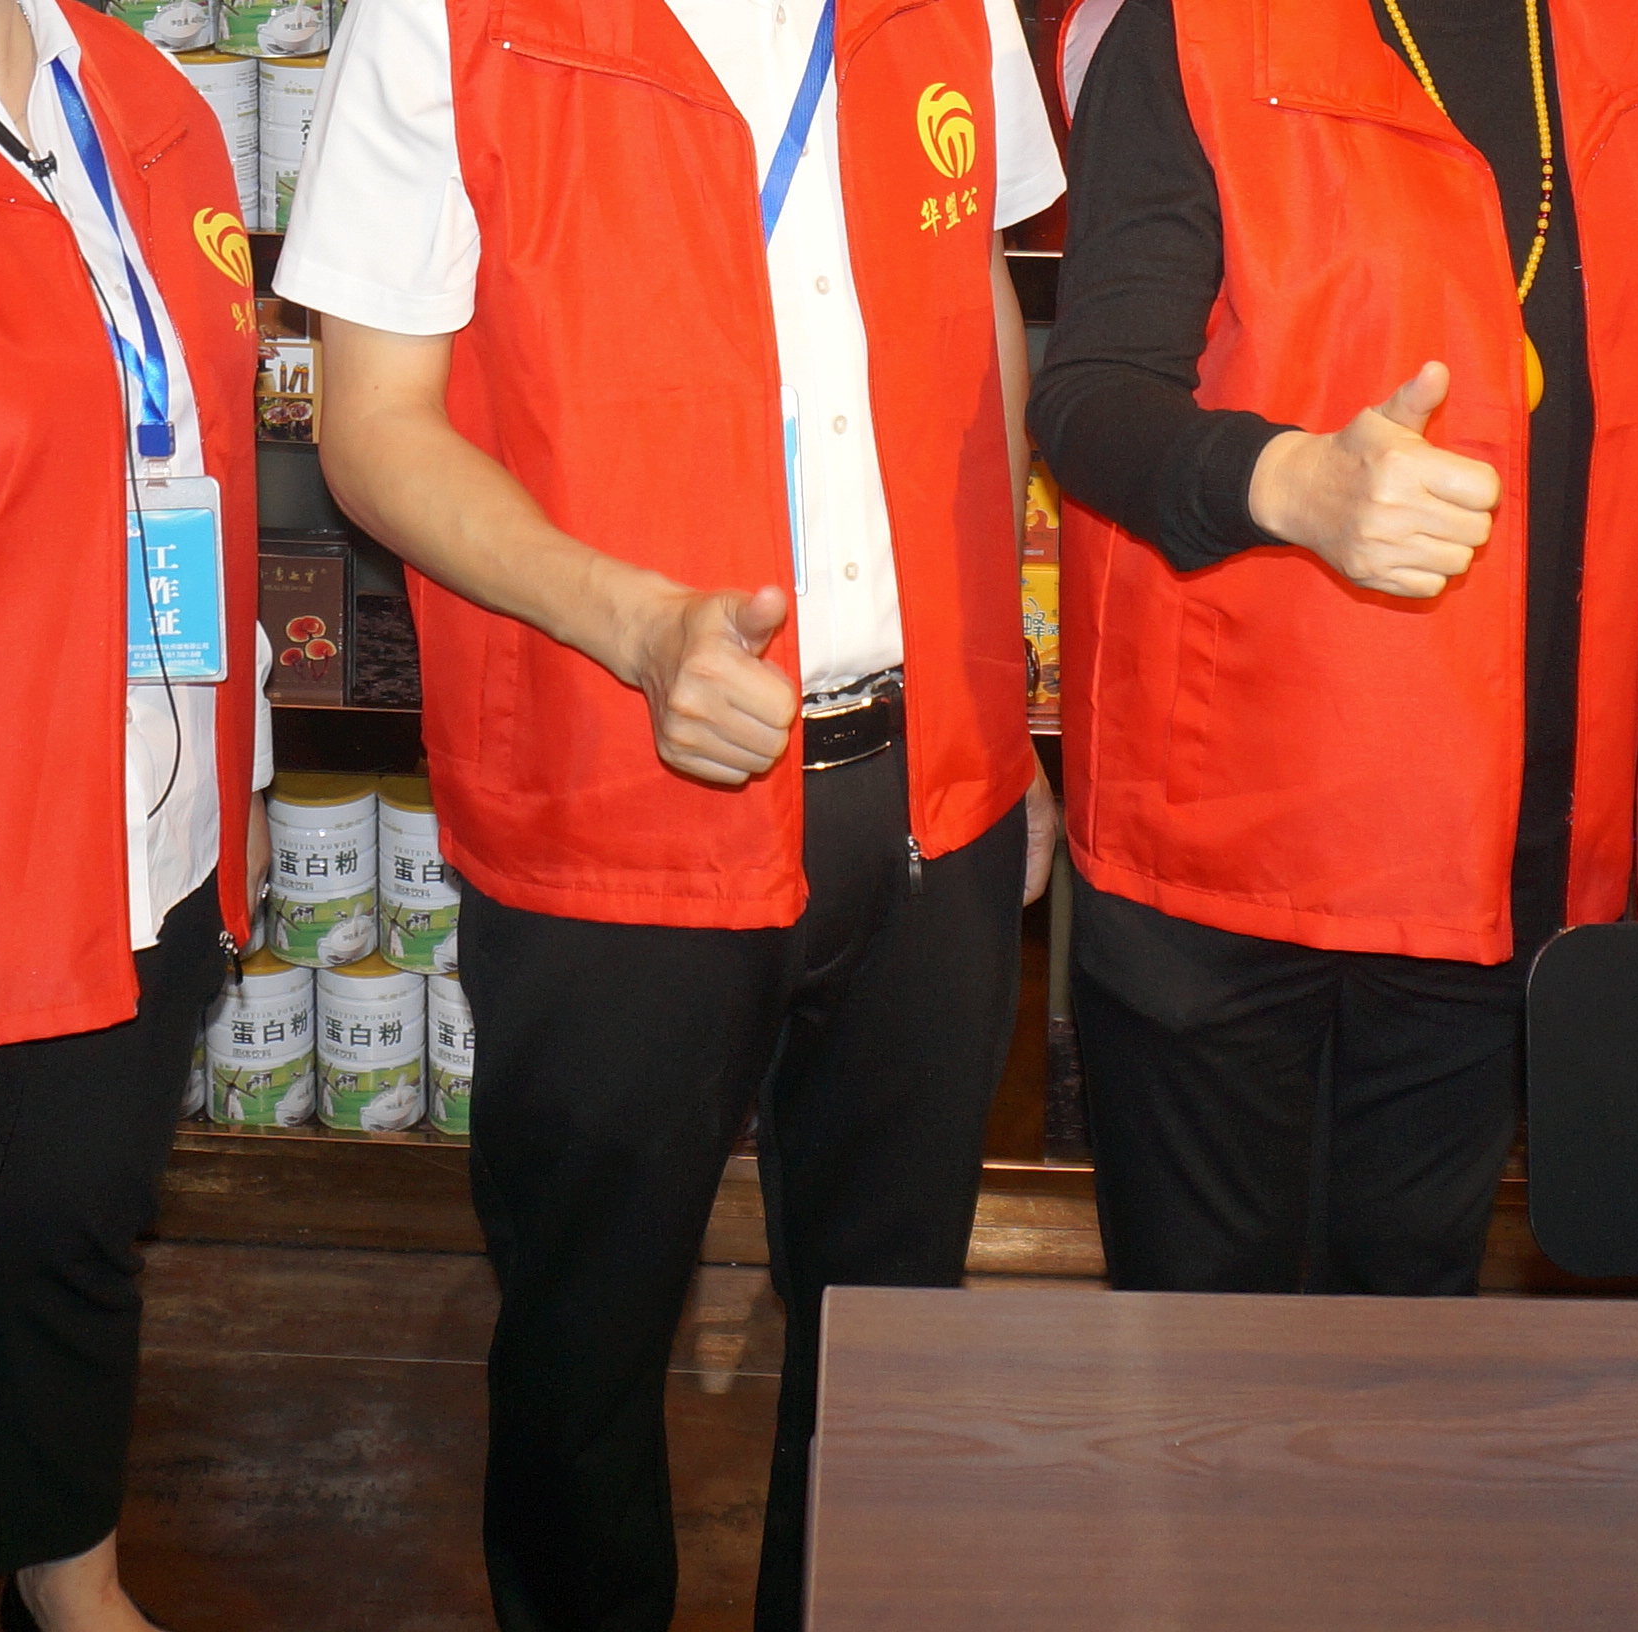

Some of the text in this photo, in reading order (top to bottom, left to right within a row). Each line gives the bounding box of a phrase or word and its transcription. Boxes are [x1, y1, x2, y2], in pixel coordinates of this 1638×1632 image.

[146, 543, 182, 636] 工作证
[278, 848, 359, 879] 蛋白粉
[393, 855, 457, 885] 蛋白
[231, 1011, 308, 1046] 蛋白粉
[325, 1015, 403, 1047] 蛋白粉
